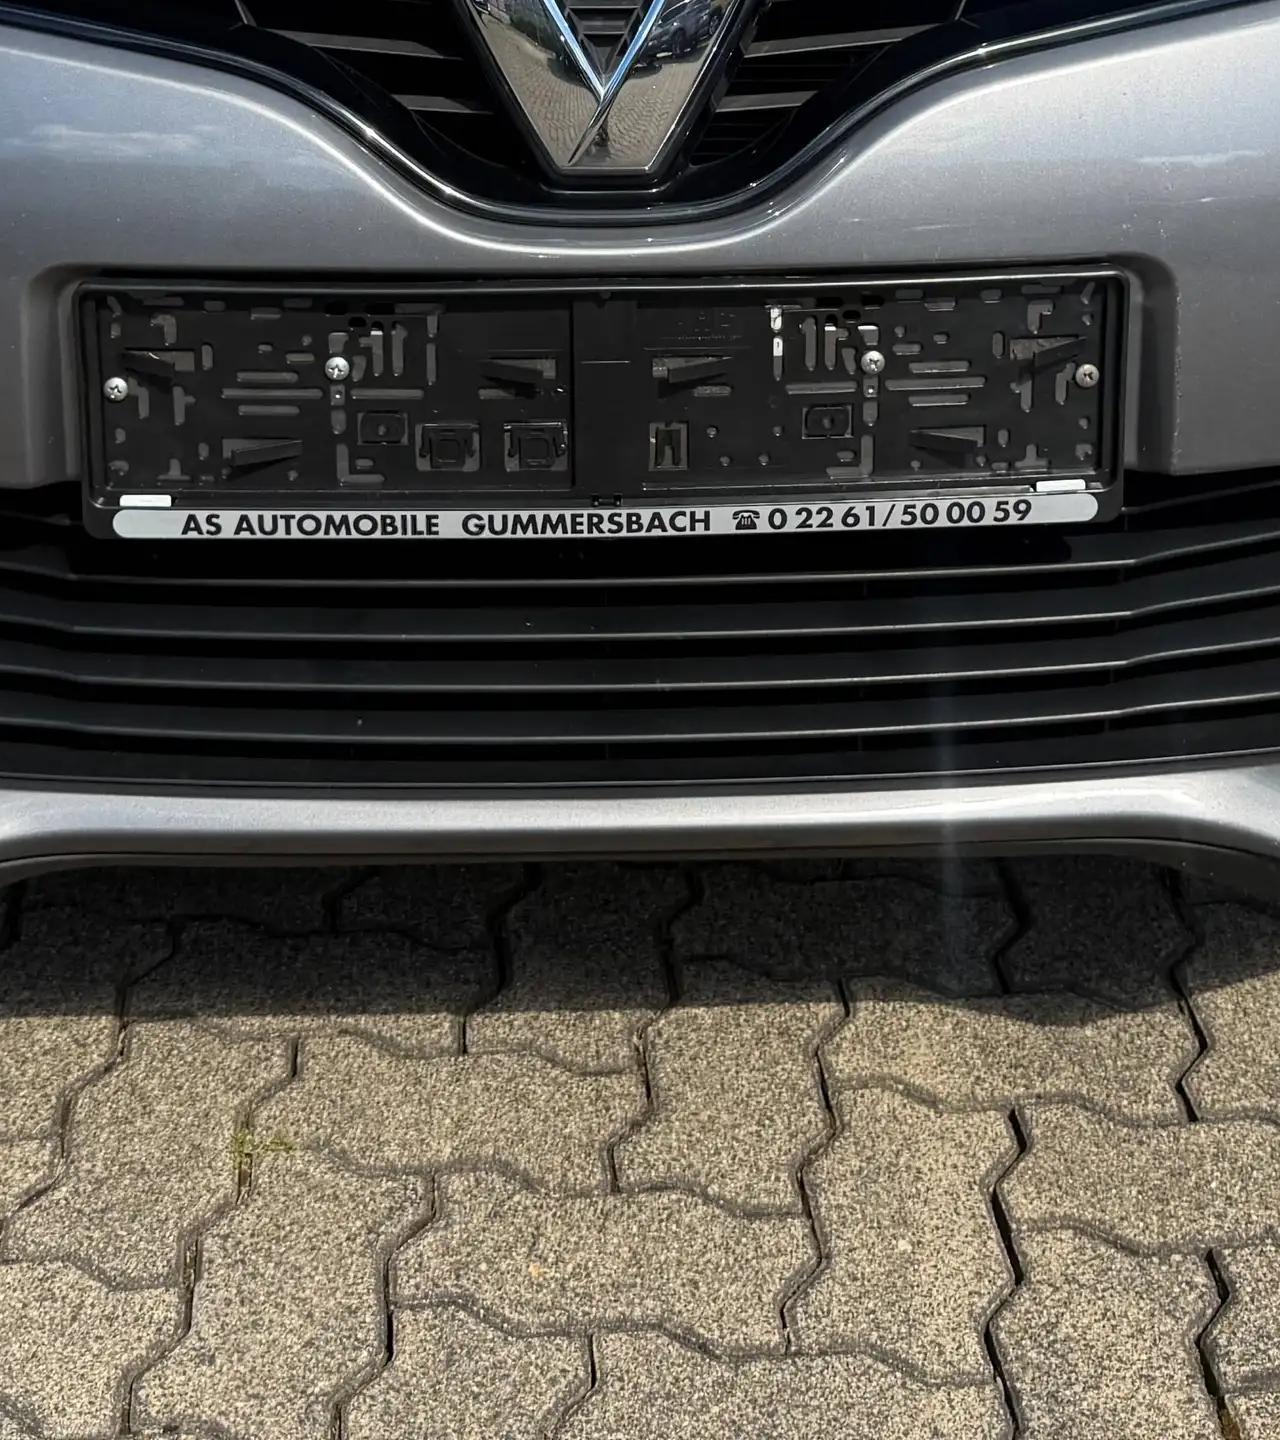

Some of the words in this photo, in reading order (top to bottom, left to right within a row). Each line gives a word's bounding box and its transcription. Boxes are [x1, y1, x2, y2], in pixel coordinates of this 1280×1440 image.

[181, 513, 222, 536] AS
[233, 513, 440, 537] AUTOMOBILE
[461, 510, 711, 537] GUMMERSBACH
